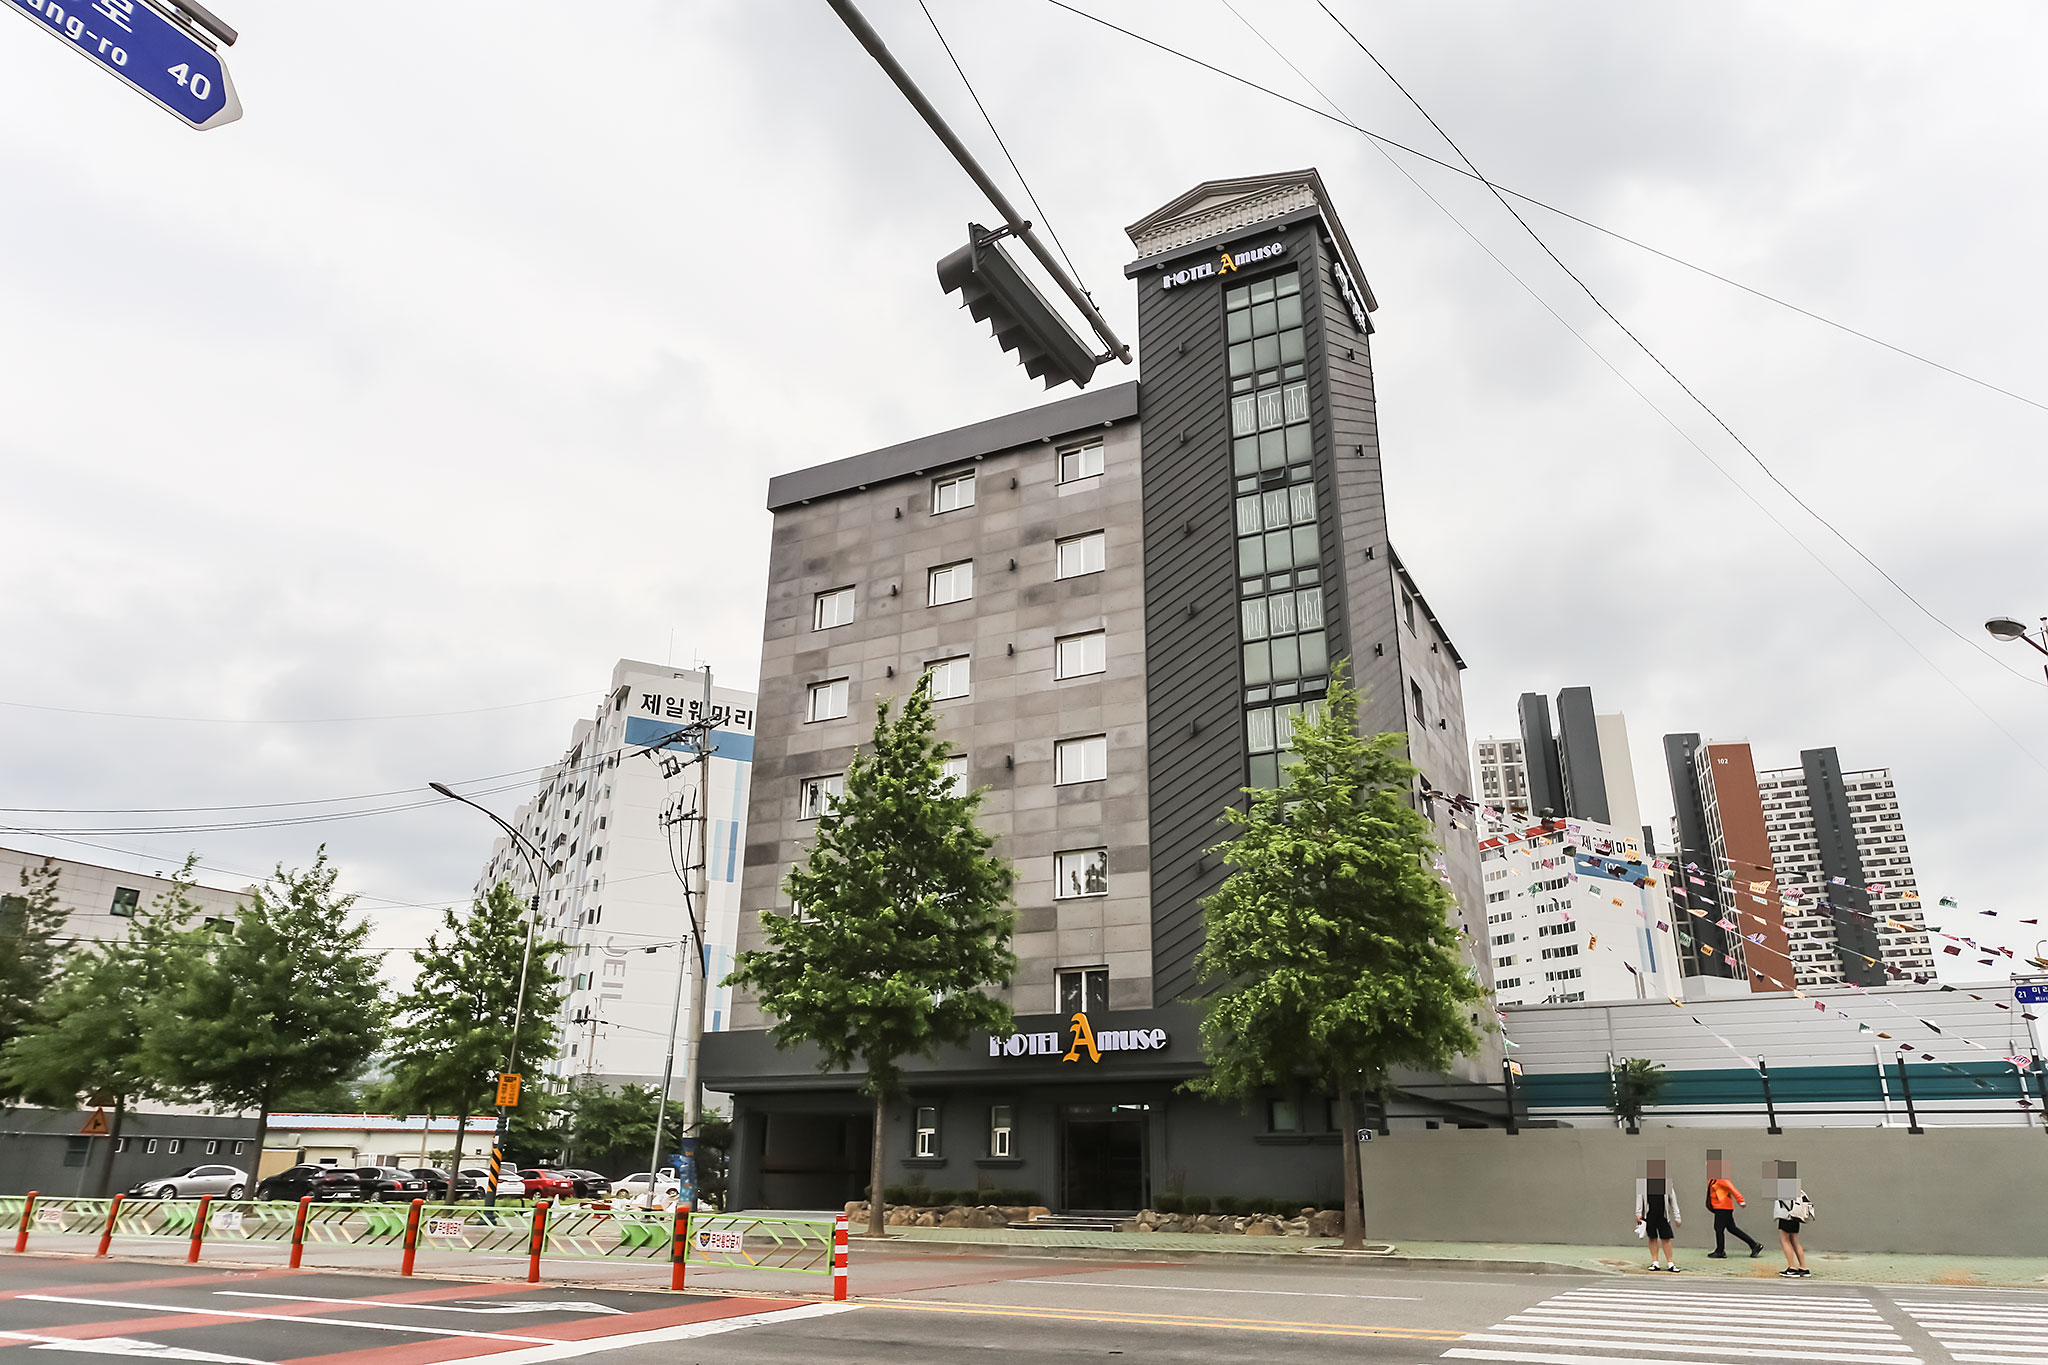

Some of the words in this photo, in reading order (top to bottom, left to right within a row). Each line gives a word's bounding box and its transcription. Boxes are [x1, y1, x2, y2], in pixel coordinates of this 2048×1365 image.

[167, 62, 211, 101] 40
[1162, 262, 1216, 289] HOTEL
[1218, 242, 1284, 276] Amuse
[600, 935, 627, 1010] JEIL
[2017, 990, 2027, 999] 21
[989, 1031, 1063, 1057] HOTEL
[1062, 1012, 1167, 1063] Amuse
